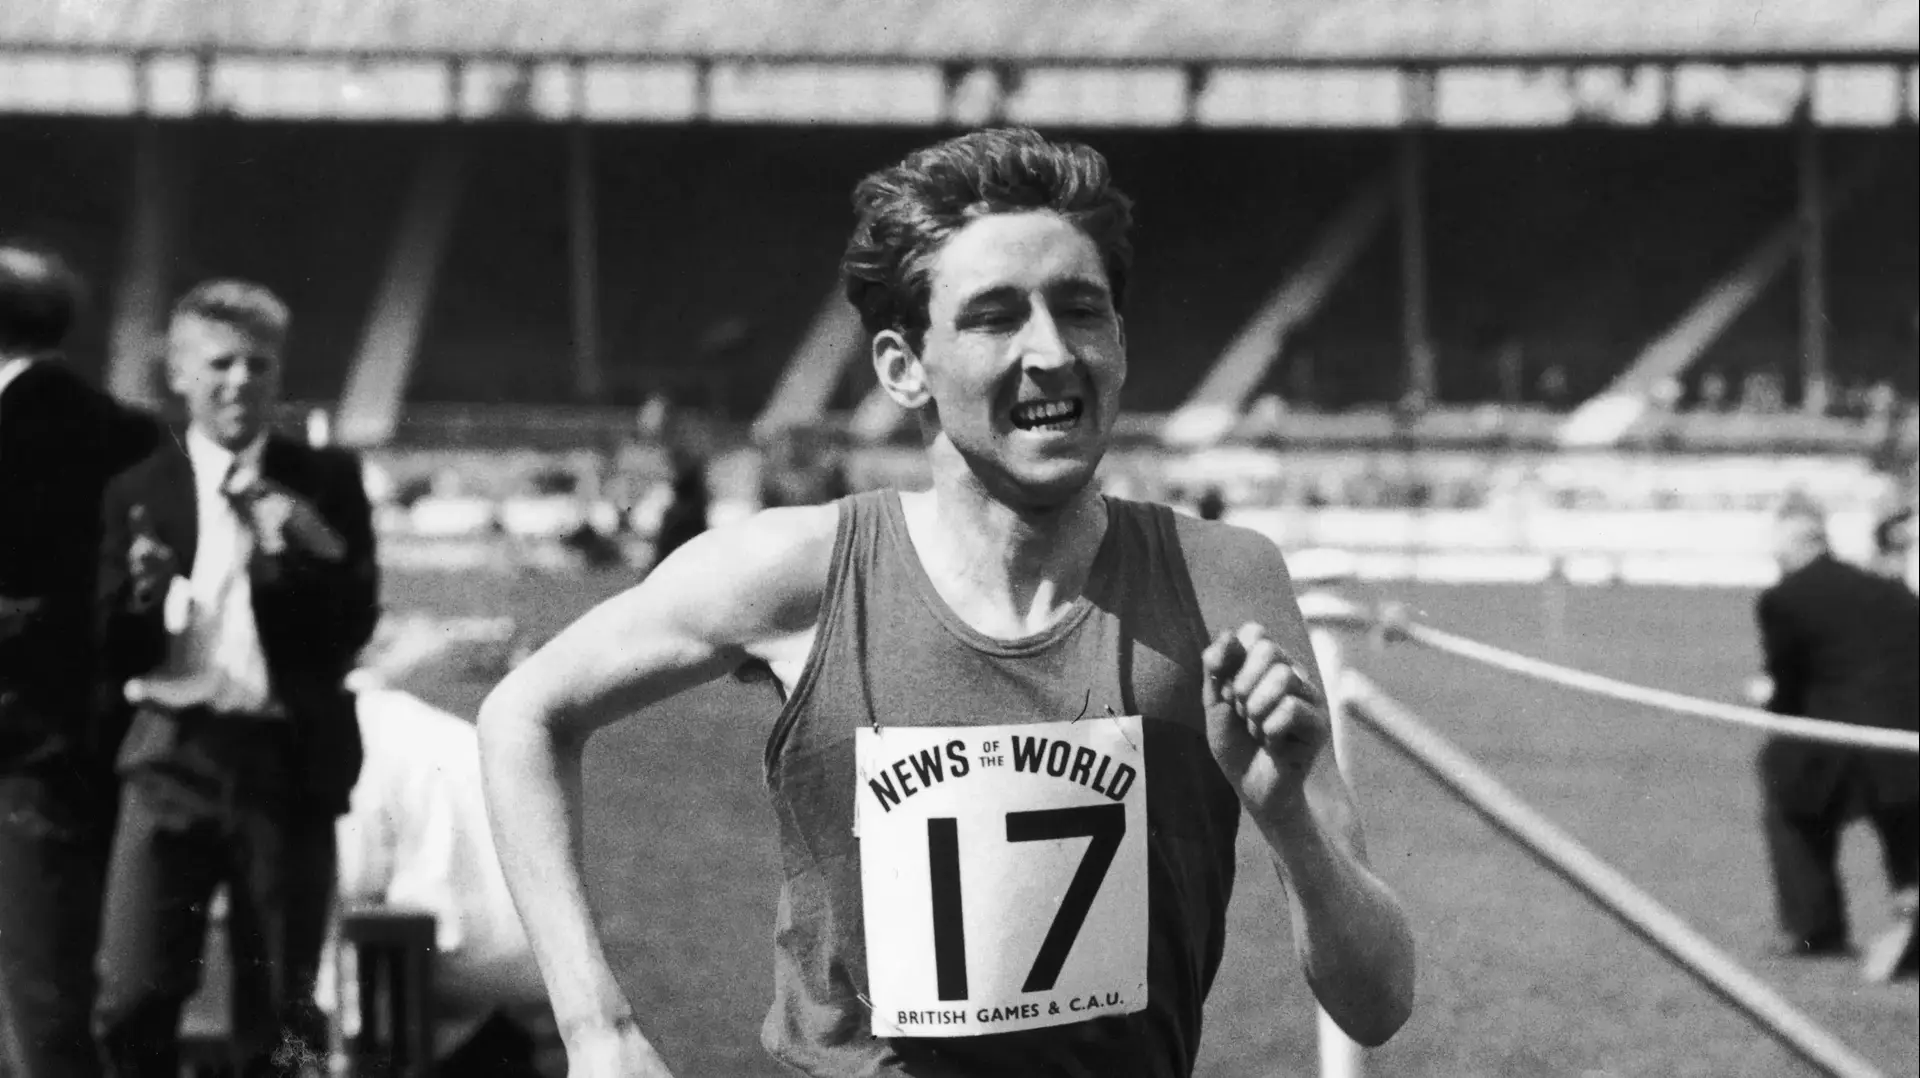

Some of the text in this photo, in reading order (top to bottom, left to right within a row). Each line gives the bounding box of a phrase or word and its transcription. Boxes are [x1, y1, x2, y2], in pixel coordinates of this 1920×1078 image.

[868, 735, 1136, 813] NEWS OF THE WORLD
[927, 803, 1126, 1002] 17
[898, 992, 1124, 1024] BRITISH GAMES & C.A.U.
